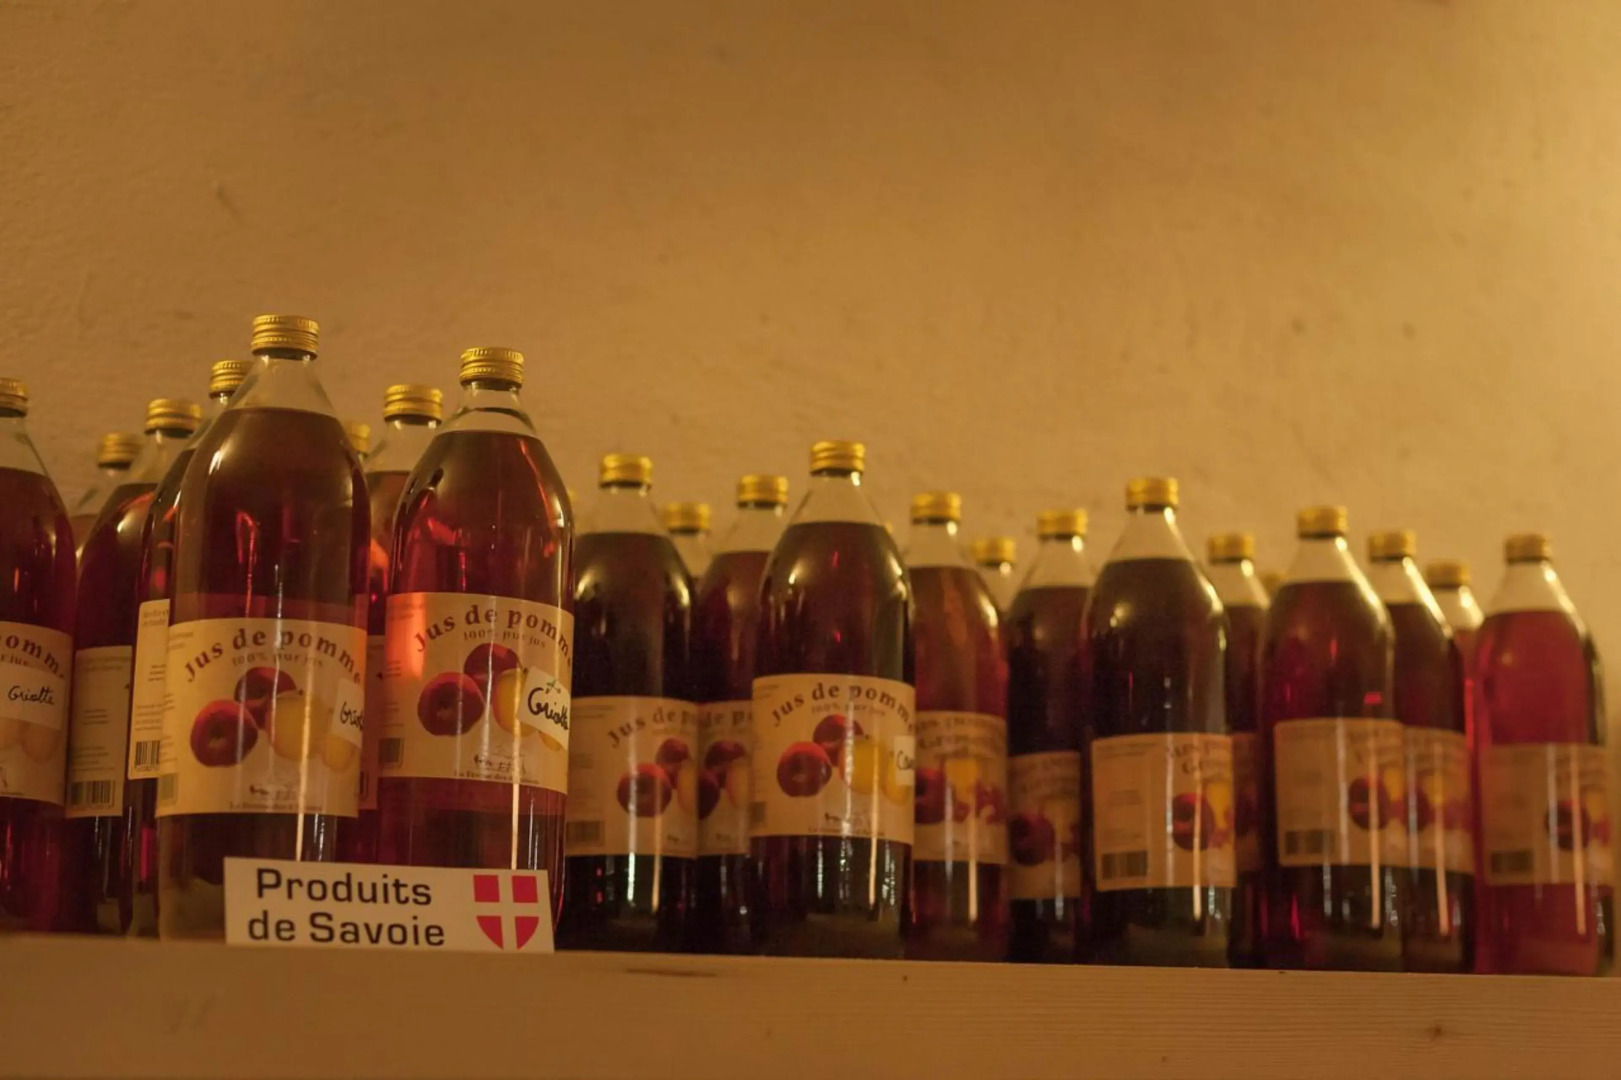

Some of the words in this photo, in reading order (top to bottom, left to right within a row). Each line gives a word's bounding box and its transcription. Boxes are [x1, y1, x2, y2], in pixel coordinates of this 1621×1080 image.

[465, 604, 498, 626] de
[232, 627, 267, 651] de
[811, 681, 840, 701] de
[256, 867, 432, 906] Produits
[248, 909, 296, 942] de
[309, 911, 445, 946] Savoie
